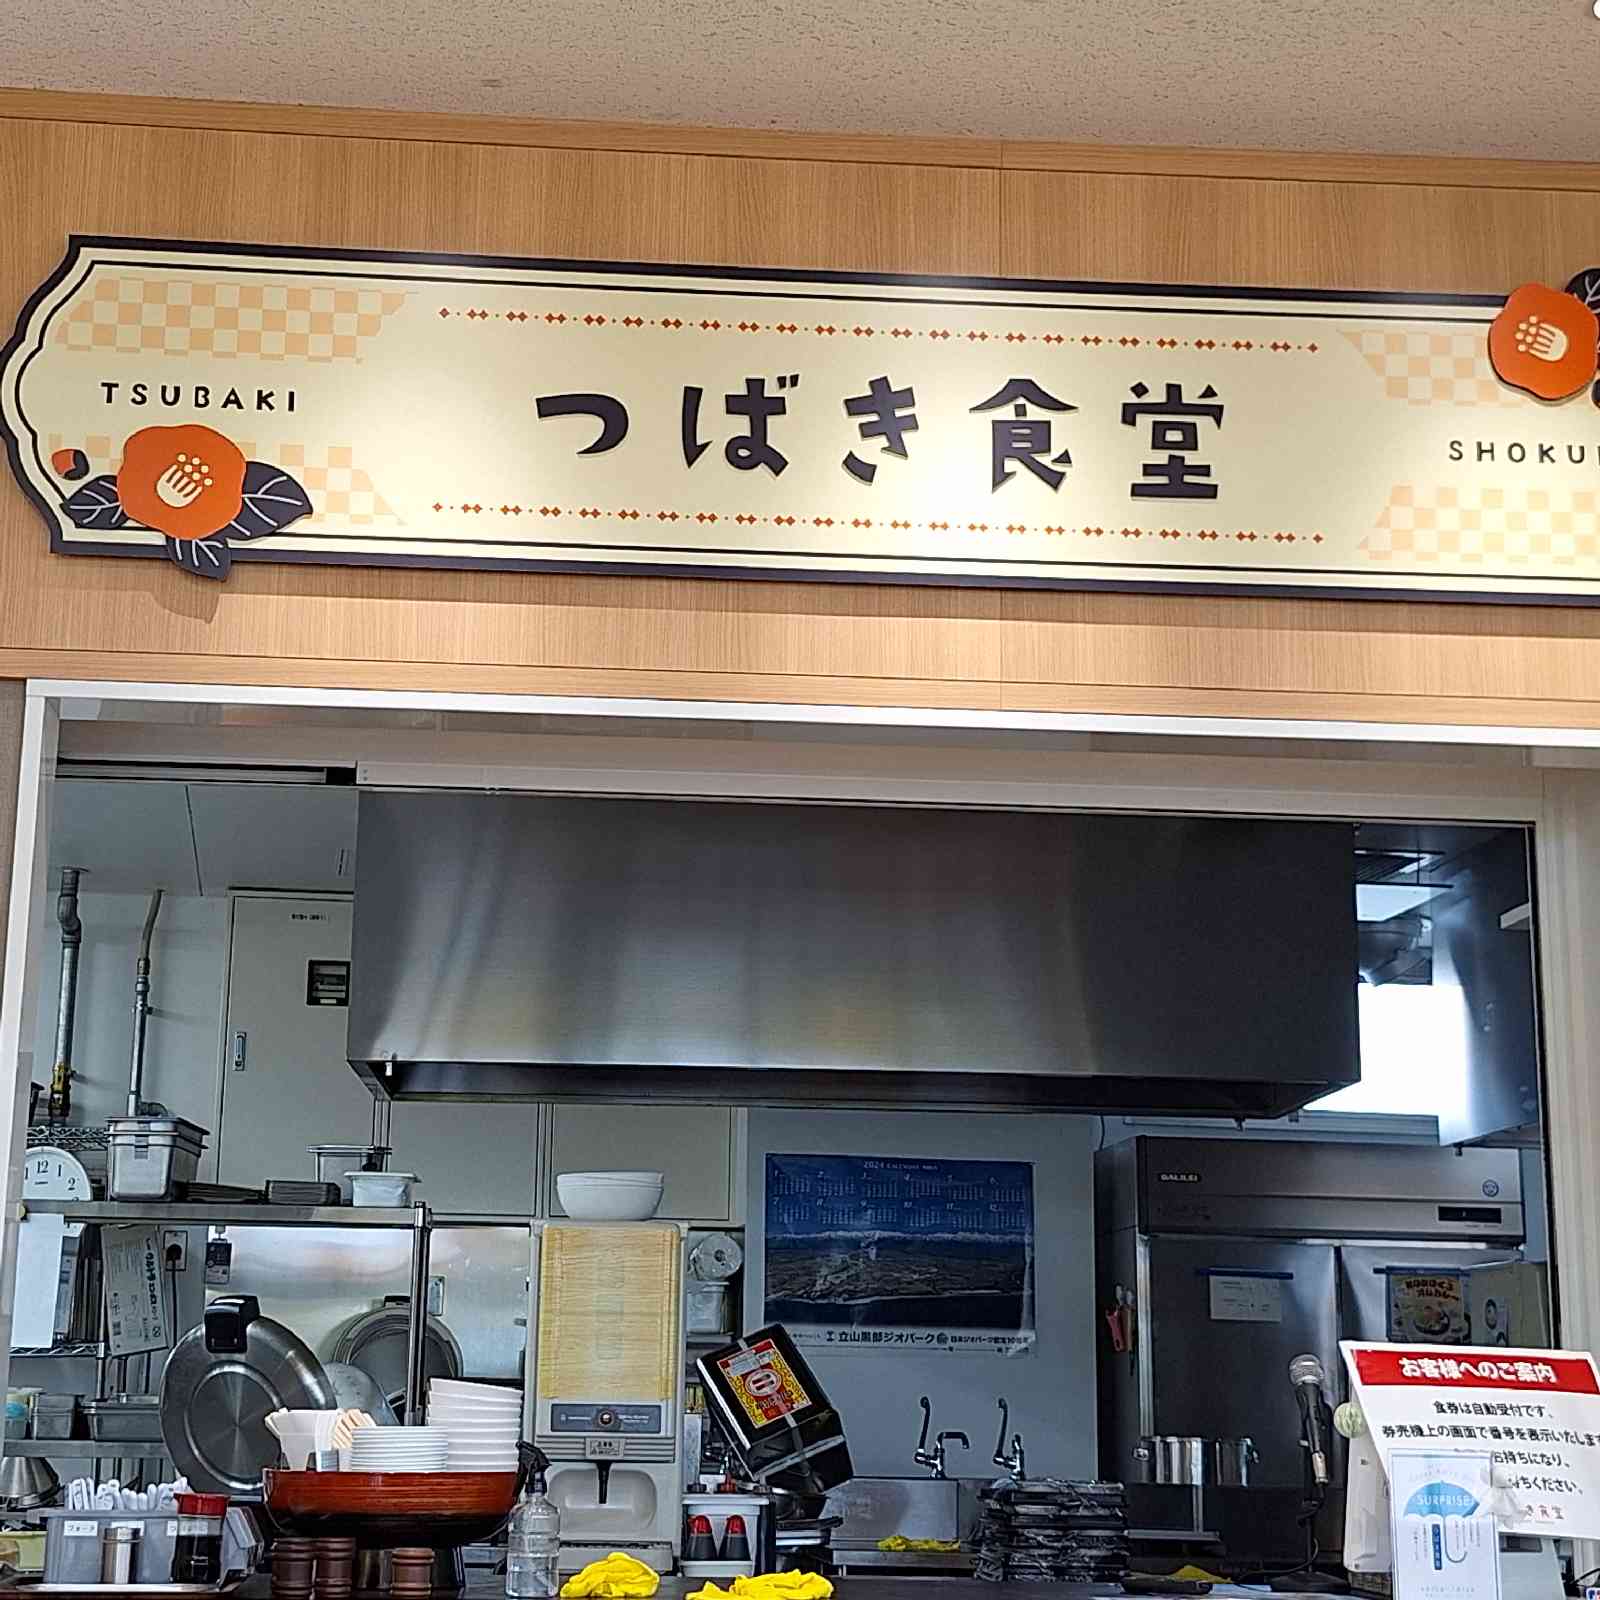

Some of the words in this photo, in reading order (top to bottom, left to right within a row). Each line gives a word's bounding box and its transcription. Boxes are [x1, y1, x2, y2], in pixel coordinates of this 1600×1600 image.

[101, 382, 296, 412] TSUBAKI
[536, 374, 1225, 501] つばき食堂
[1449, 440, 1600, 465] SHOKU
[37, 1160, 49, 1174] 12
[68, 1177, 76, 1191] 2
[838, 1330, 935, 1344] 立山黒部ジオパーク
[1399, 1357, 1557, 1384] お客様へのご案内
